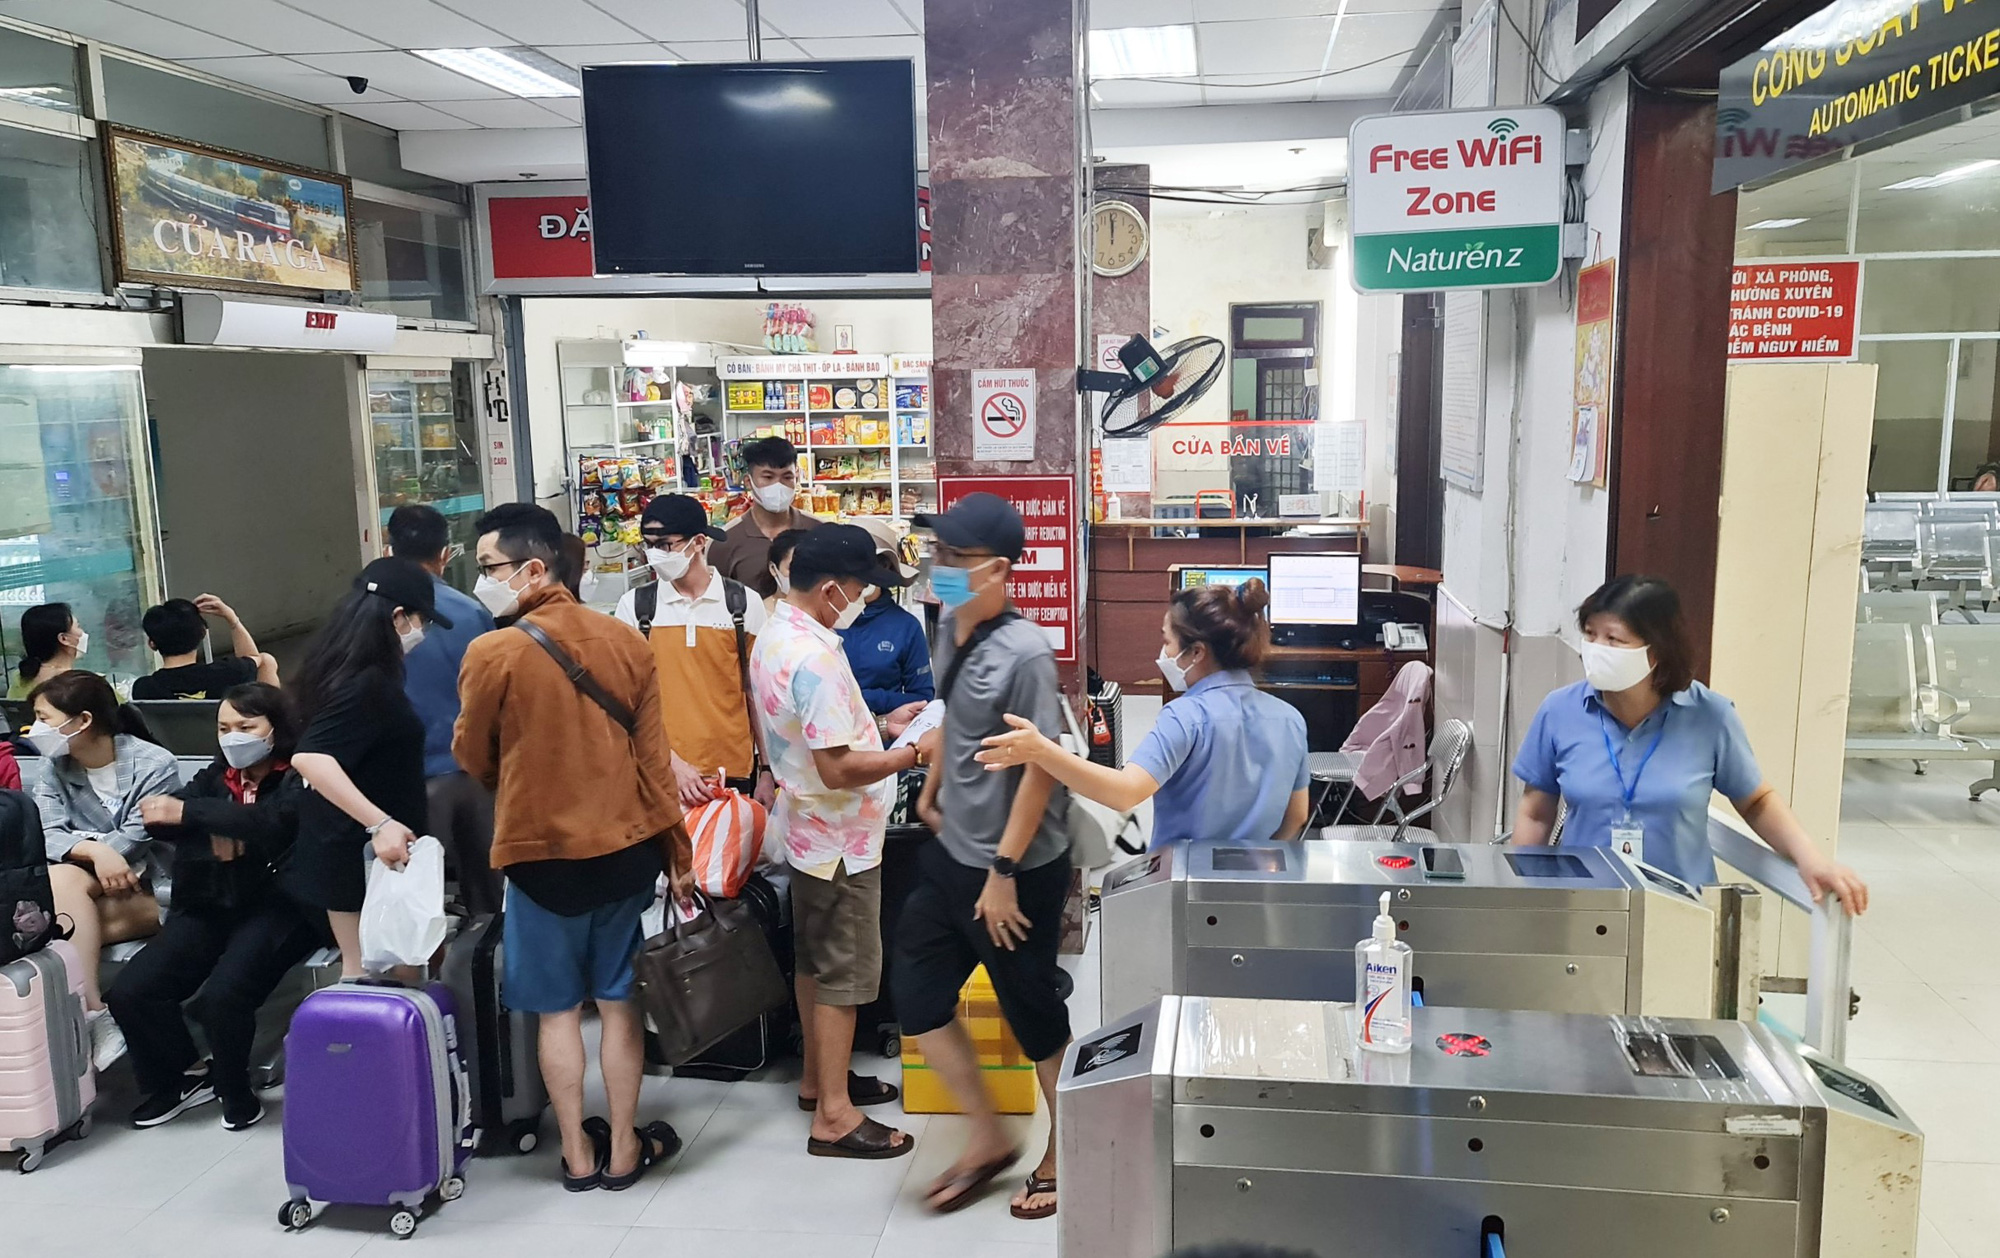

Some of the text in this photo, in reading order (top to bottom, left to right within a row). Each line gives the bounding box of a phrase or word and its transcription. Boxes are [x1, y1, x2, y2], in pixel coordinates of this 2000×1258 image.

[1808, 28, 2000, 138] AUTOMATIC TICKE
[1370, 134, 1542, 173] Free WiFi
[1407, 187, 1496, 216] Zone
[153, 213, 327, 273] CỬA RA GA
[1755, 268, 1776, 284] XÀ
[1784, 283, 1833, 300] XUYÊN
[306, 311, 338, 329] EXIT
[1777, 305, 1843, 320] COVID-19
[1753, 321, 1792, 339] BỆNH
[1758, 340, 1798, 353] NGUY
[833, 363, 841, 372] LA
[994, 376, 1007, 388] HÚT
[1172, 433, 1290, 455] CỬA BÁN VÉ
[1058, 495, 1066, 516] VÉ
[1040, 526, 1066, 540] REDUCTION
[1059, 578, 1067, 598] VÉ
[1041, 607, 1068, 621] EXEMPTION
[1366, 962, 1397, 975] Aiken
